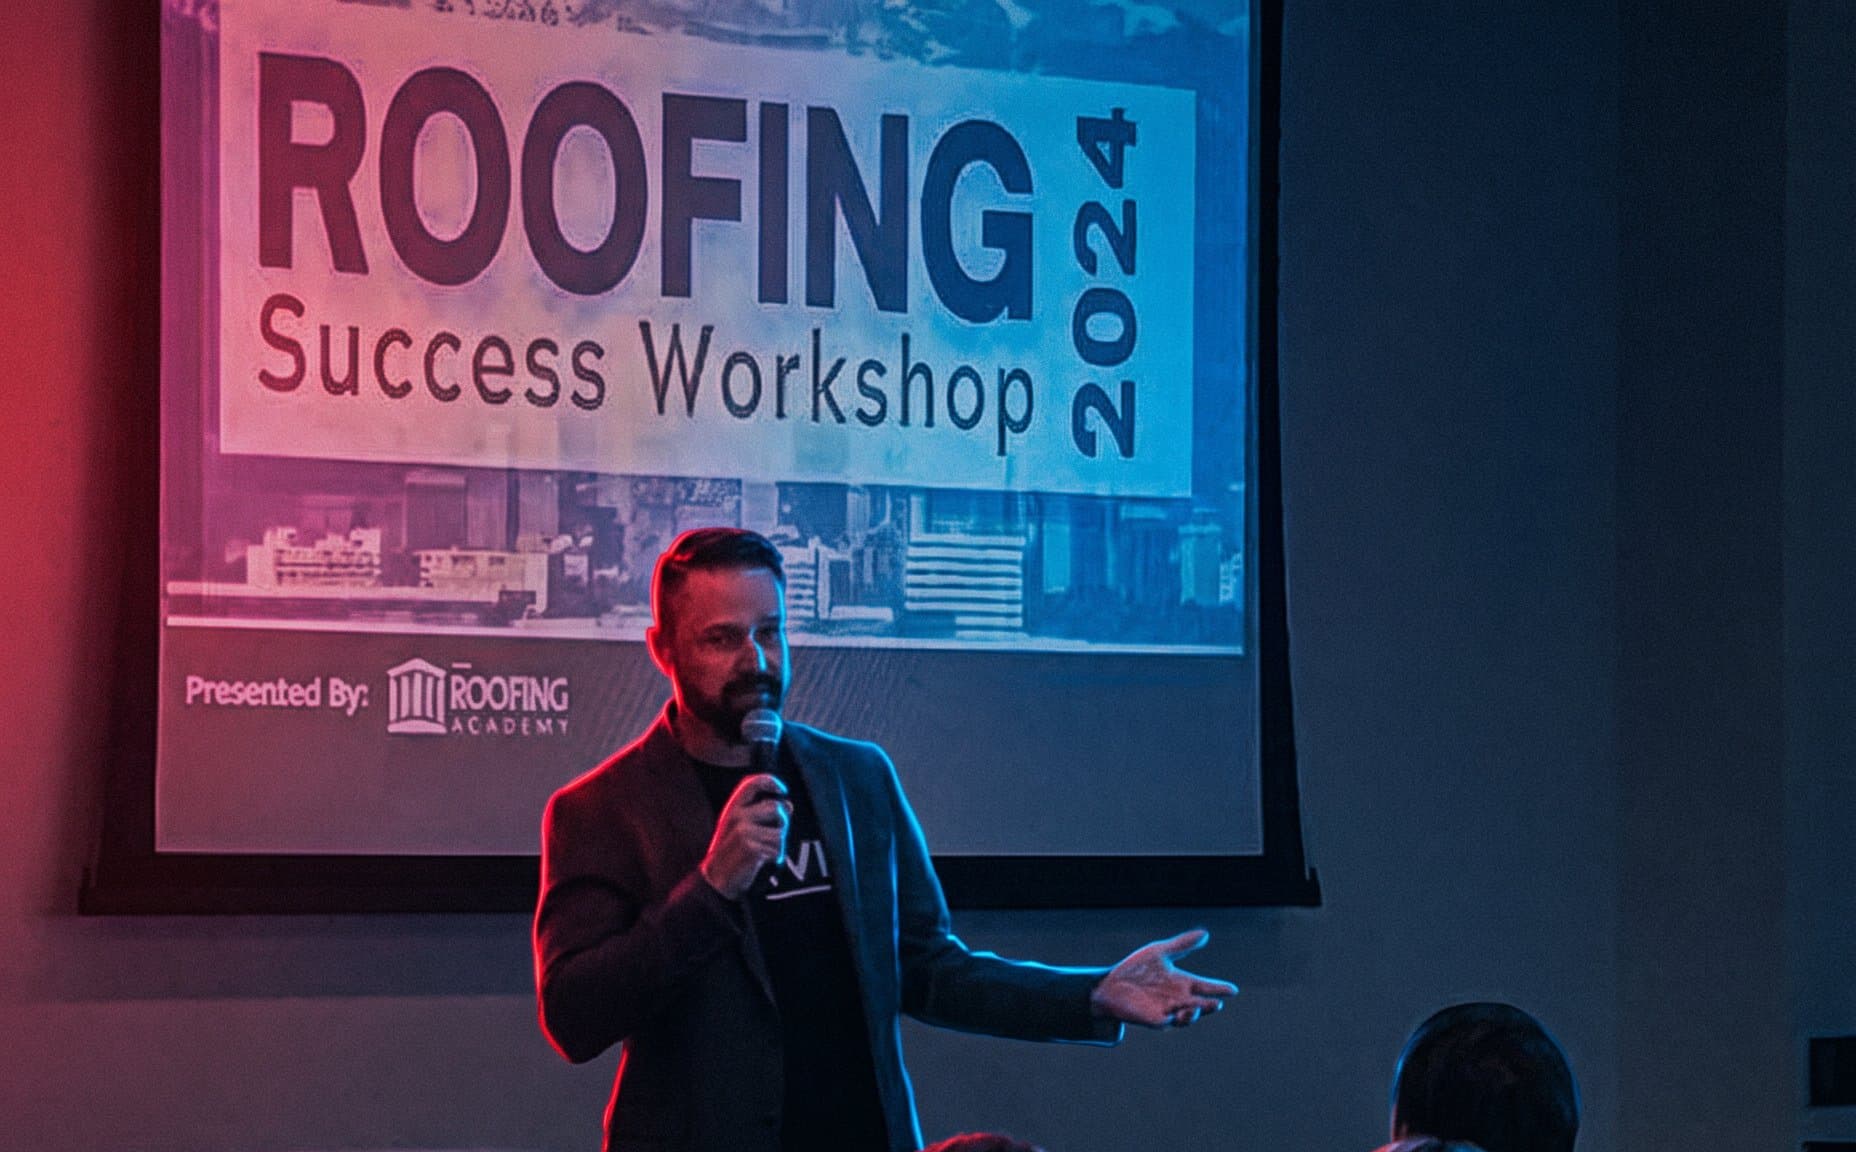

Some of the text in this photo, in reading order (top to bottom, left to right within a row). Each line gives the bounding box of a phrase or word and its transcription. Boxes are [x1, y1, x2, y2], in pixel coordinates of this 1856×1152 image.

[258, 51, 1035, 322] ROOFING
[1073, 107, 1138, 460] 2024
[257, 292, 1036, 457] Success Workshop
[185, 675, 369, 716] Presented By:
[450, 674, 569, 712] ROOFING
[451, 715, 569, 736] ACADEMY
